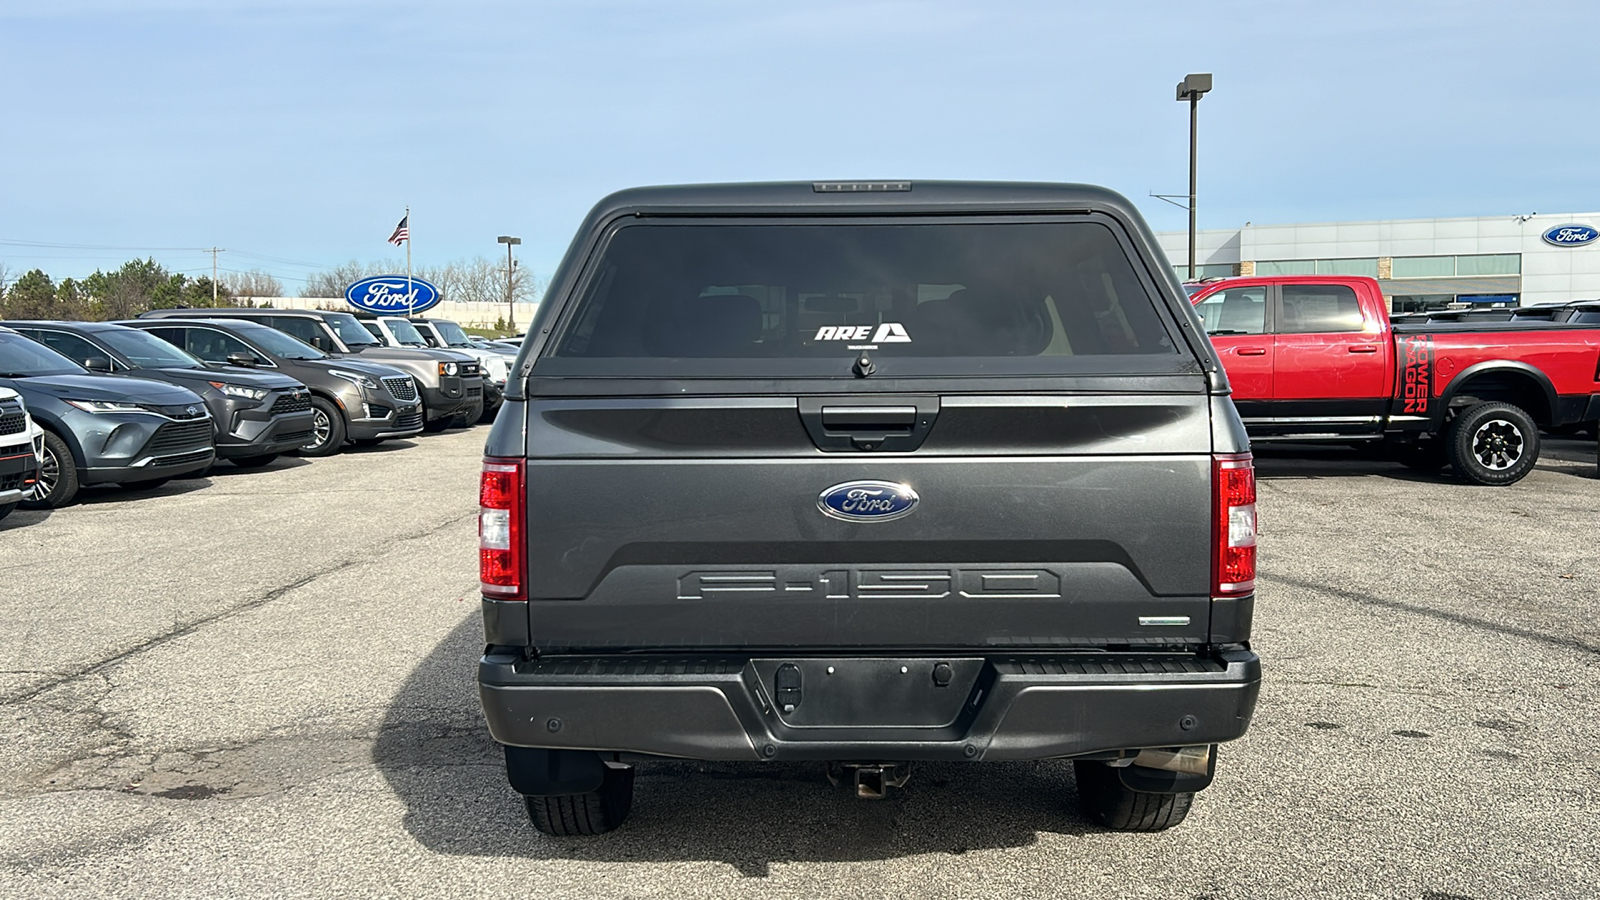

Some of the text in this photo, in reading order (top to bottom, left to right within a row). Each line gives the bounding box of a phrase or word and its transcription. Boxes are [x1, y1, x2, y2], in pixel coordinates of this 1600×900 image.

[1556, 228, 1590, 242] Ford
[363, 282, 419, 306] Ford
[814, 325, 874, 341] ARE
[1403, 335, 1417, 413] WAGON
[1416, 334, 1429, 413] POWER
[842, 489, 896, 511] Ford
[677, 570, 1061, 599] F-150
